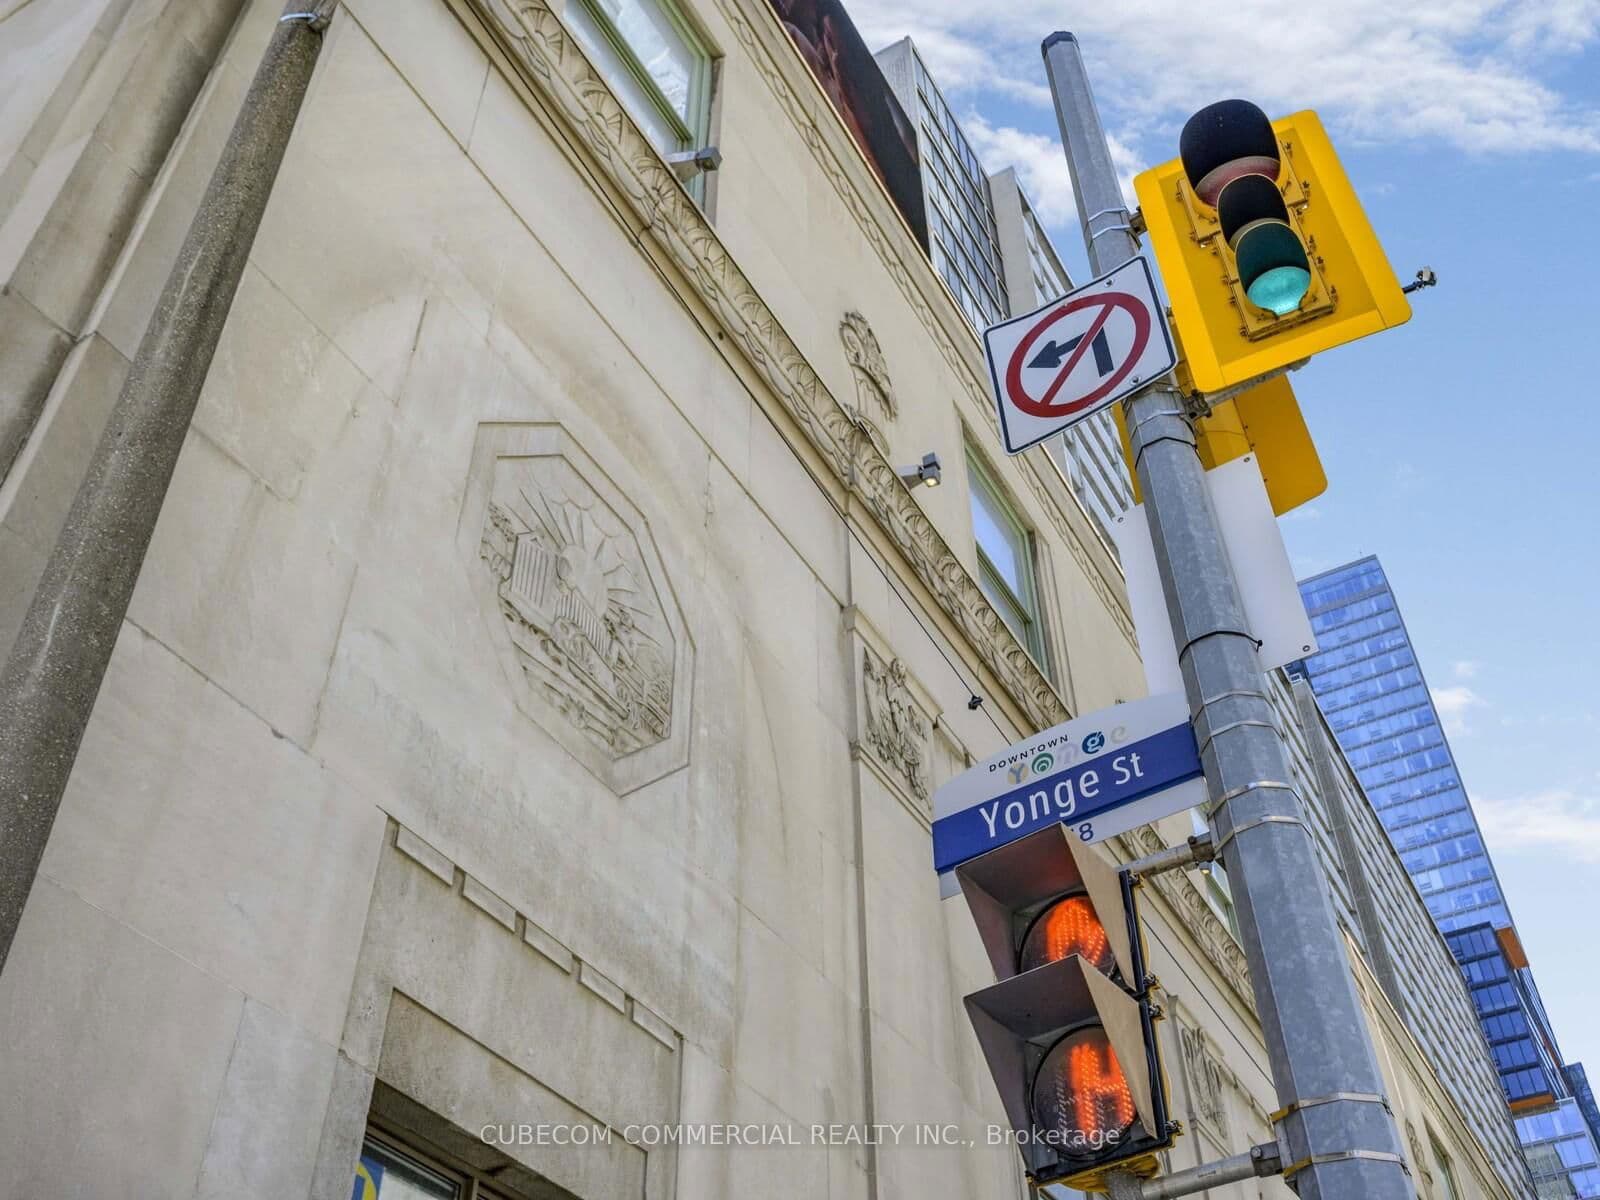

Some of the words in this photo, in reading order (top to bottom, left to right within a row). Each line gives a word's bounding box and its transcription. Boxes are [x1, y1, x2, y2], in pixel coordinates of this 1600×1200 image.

[989, 734, 1069, 773] DOWNTOWN
[979, 770, 1099, 838] Yonge
[1112, 752, 1144, 785] St
